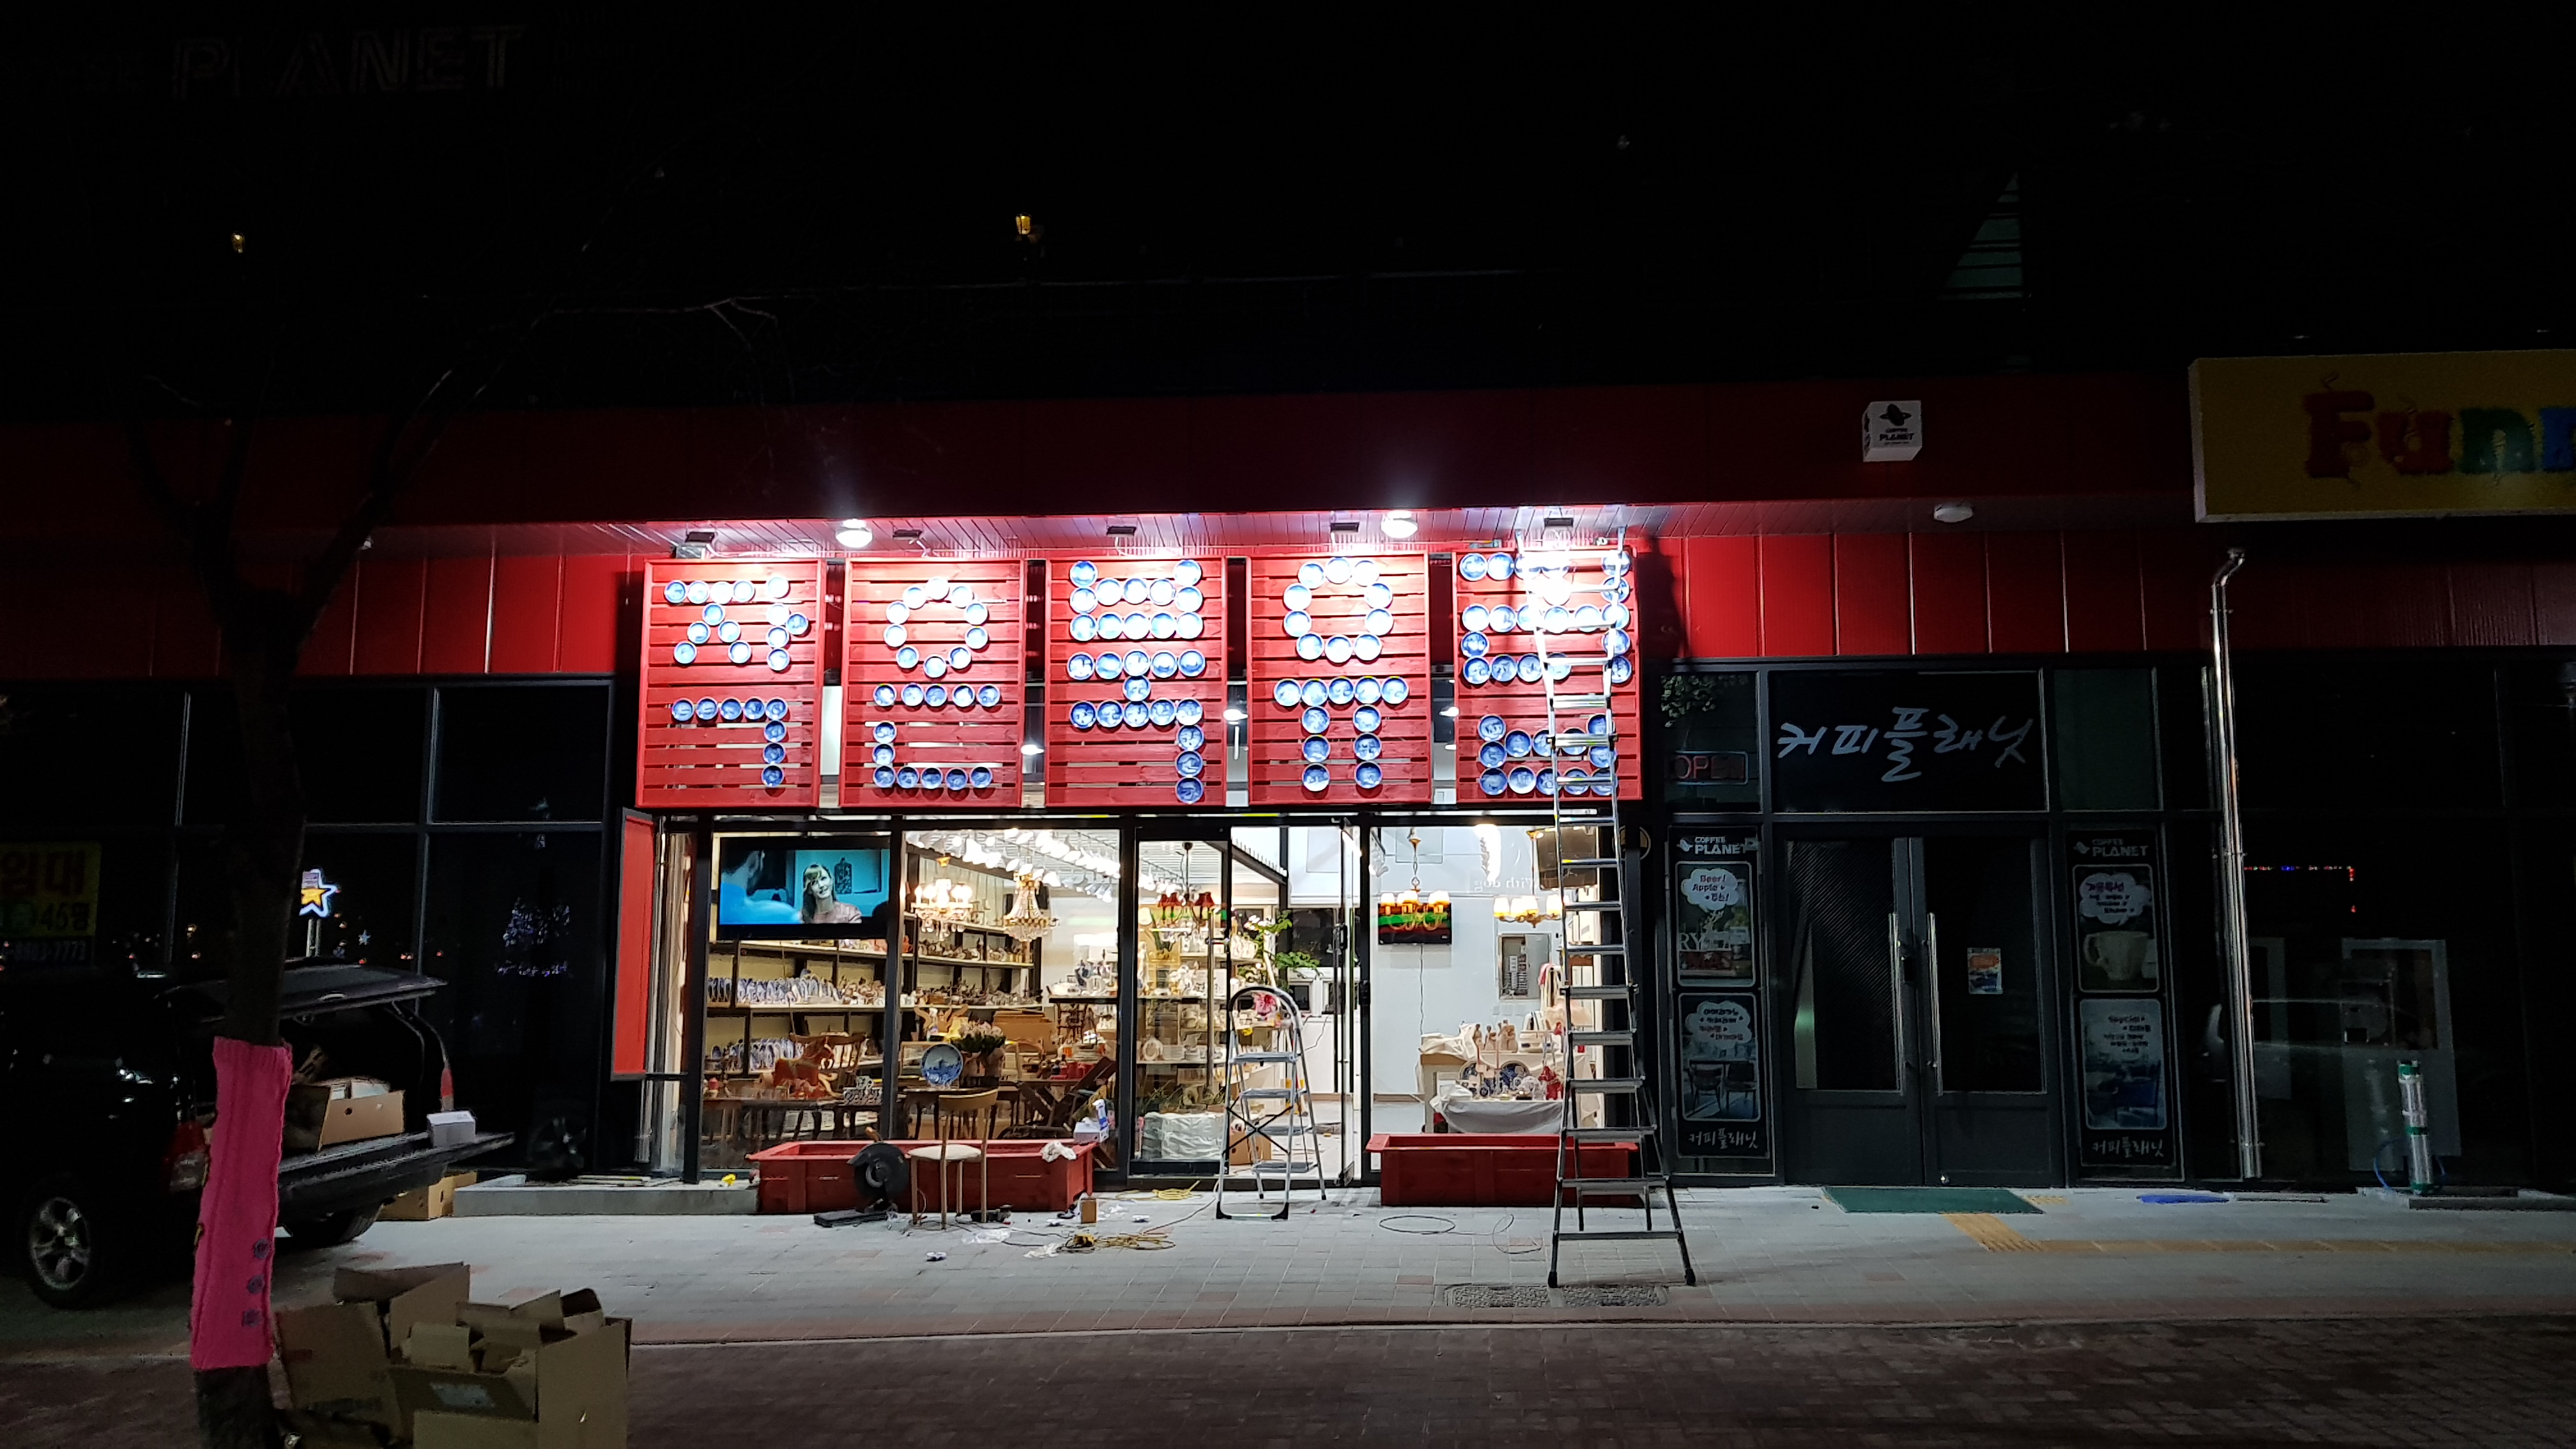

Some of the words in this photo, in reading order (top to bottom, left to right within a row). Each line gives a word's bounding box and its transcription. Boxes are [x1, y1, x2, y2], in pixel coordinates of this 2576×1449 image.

[1777, 705, 2034, 783] 커피플래닛
[2092, 845, 2149, 857] PLANET
[1687, 1127, 1759, 1150] 커피플래닛
[2091, 1135, 2165, 1158] 커피플래닛
